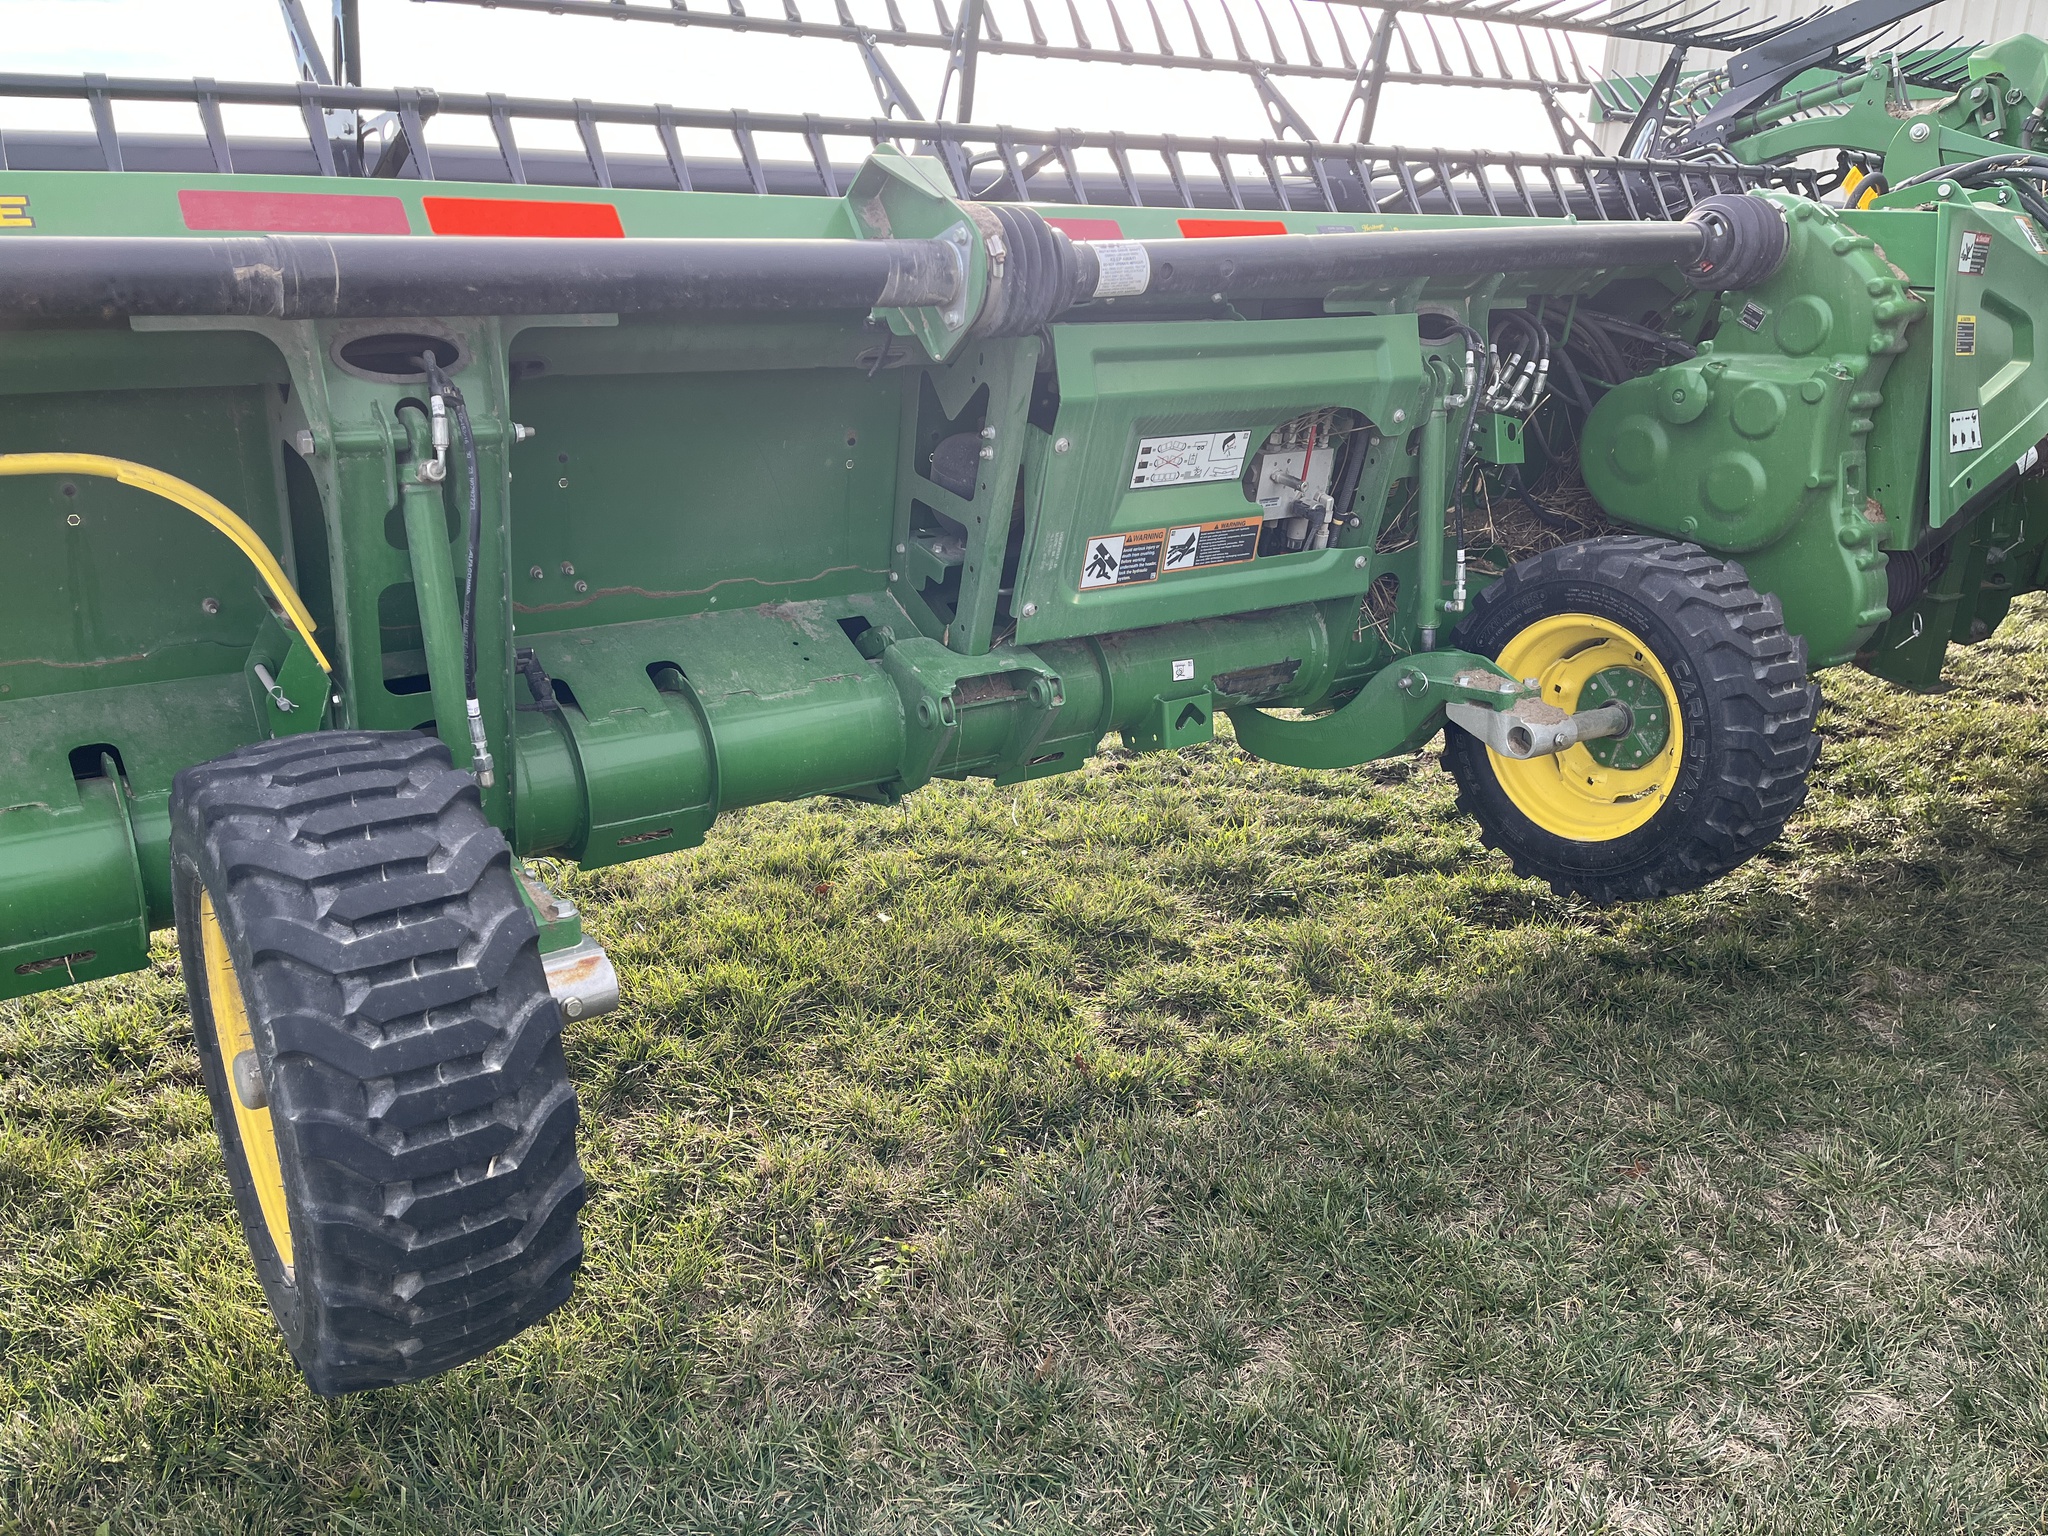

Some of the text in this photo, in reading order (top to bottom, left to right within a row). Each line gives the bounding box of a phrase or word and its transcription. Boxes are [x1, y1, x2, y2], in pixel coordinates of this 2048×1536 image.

[1221, 520, 1247, 529] WARNING
[1133, 531, 1164, 542] WARNING
[1671, 659, 1707, 813] CARLSTAR
